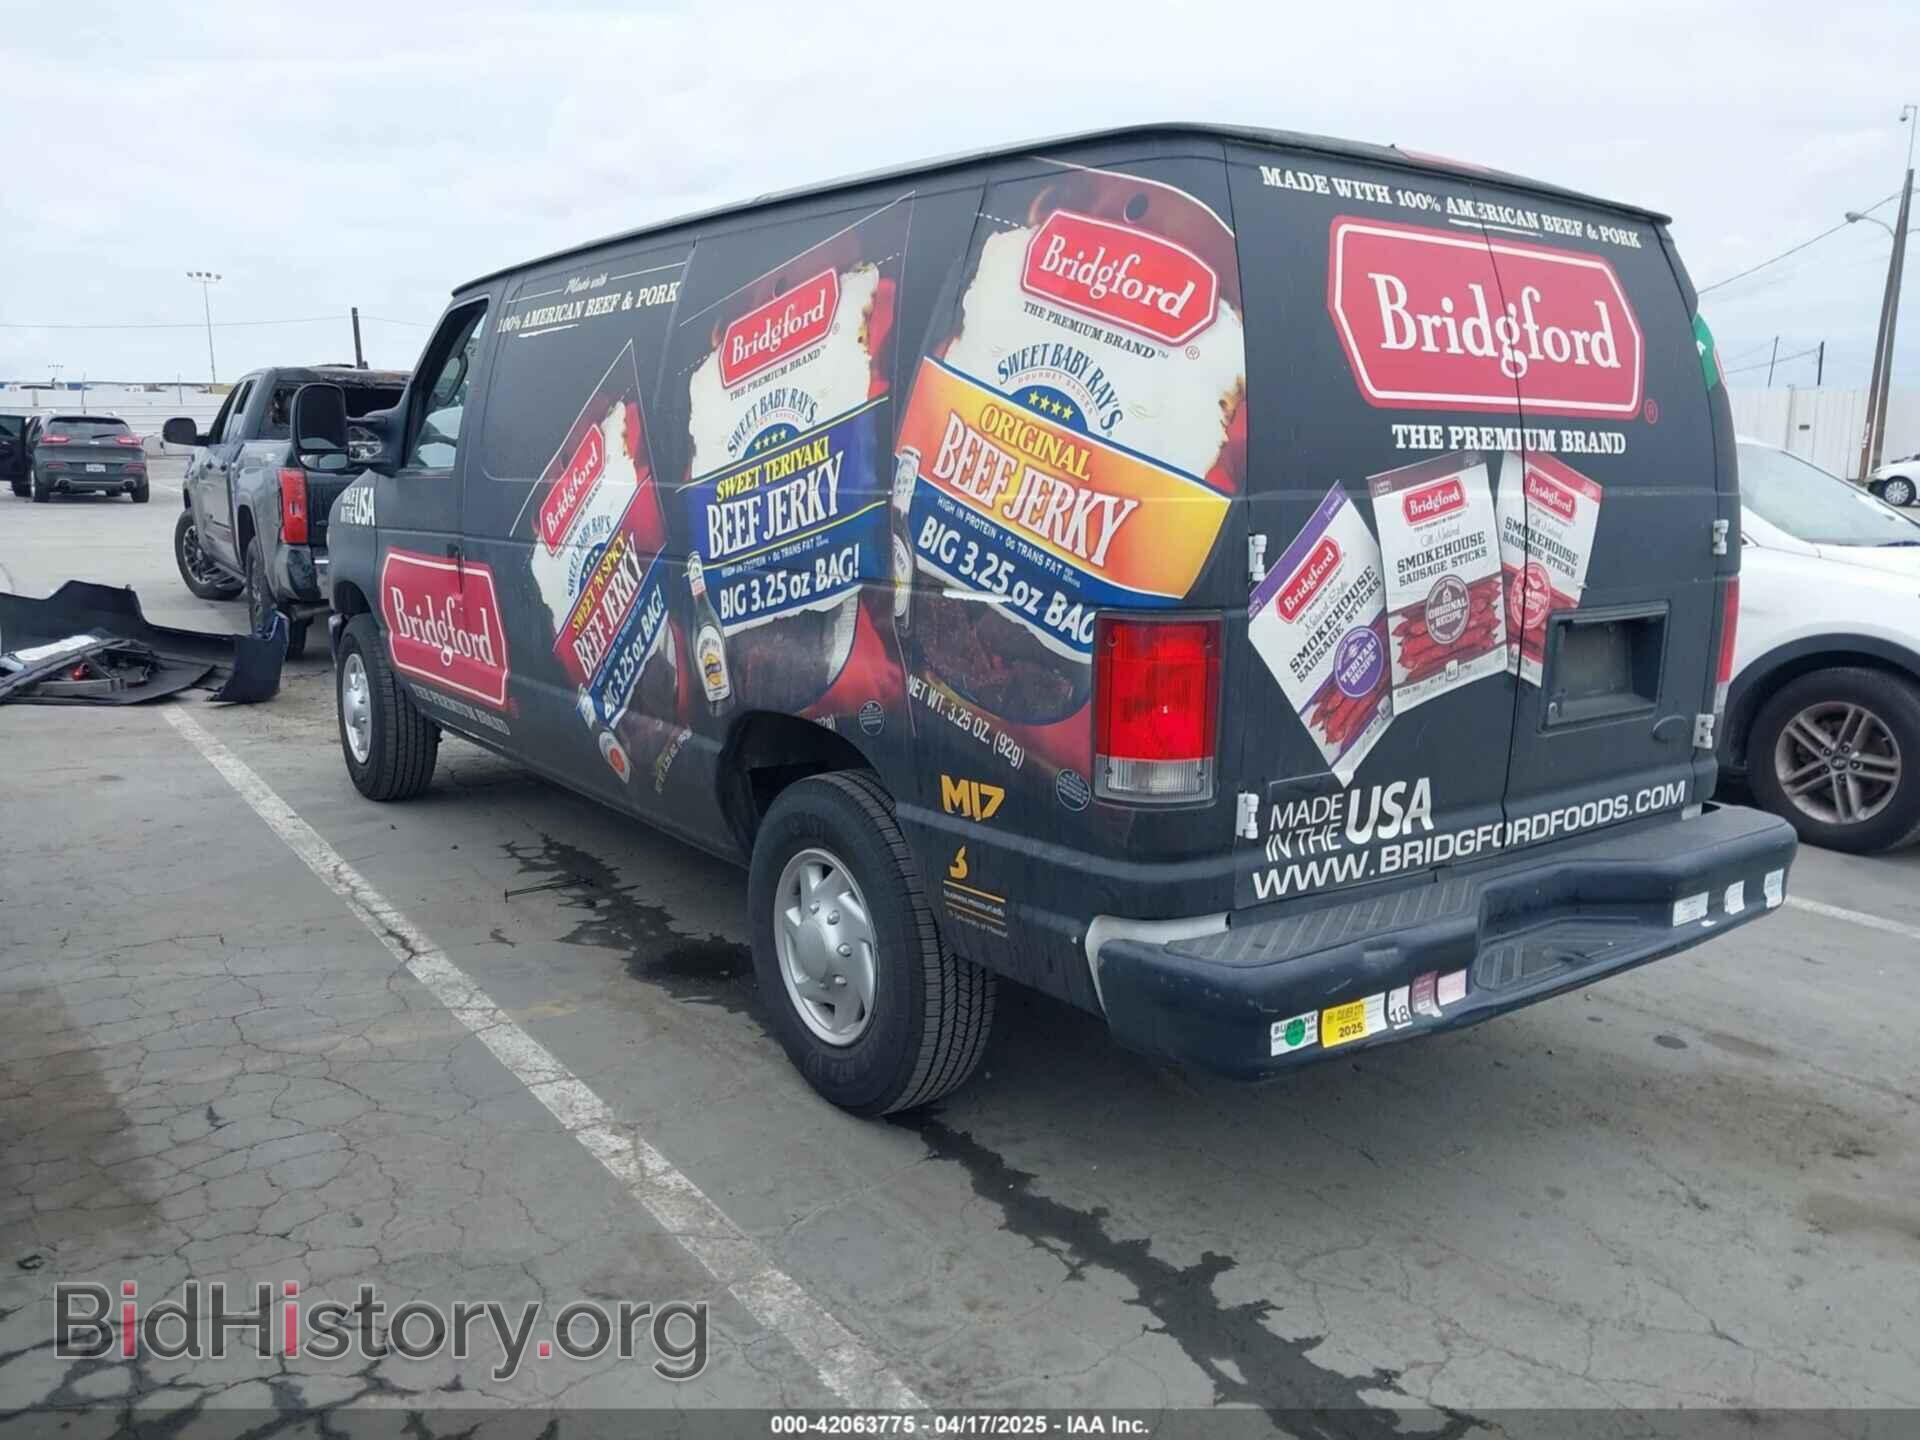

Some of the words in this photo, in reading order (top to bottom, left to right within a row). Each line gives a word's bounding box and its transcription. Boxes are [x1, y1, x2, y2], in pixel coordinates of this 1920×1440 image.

[1259, 166, 1330, 195] MADE
[1331, 177, 1393, 205] WITH
[1396, 189, 1441, 213] 100%
[1541, 214, 1585, 239] BEEF
[1586, 225, 1599, 241] &
[1598, 224, 1642, 249] PORK
[497, 314, 522, 334] 100%
[521, 300, 585, 329] AMERICAN
[584, 293, 621, 318] BEEF
[621, 290, 633, 311] &
[635, 281, 682, 308] PORK
[1039, 233, 1197, 320] Bridgford
[731, 288, 827, 367] Bridgford
[1023, 301, 1046, 319] THE
[1046, 308, 1102, 343] PREMIUM
[1368, 272, 1622, 379] Bridgford
[747, 364, 788, 393] PREMIUM
[997, 342, 1050, 386] SWEET
[1050, 342, 1094, 381] BABY
[1086, 367, 1124, 431] RAY'S
[727, 402, 758, 458] SWEET
[760, 388, 788, 415] BABY
[979, 404, 1092, 482] ORIGINAL
[1392, 424, 1445, 450] THE
[1449, 426, 1556, 453] PREMIUM
[1560, 430, 1626, 455] BRAND
[546, 441, 599, 539] Bridgford
[716, 466, 762, 503] SWEET
[763, 435, 830, 484] TERIYAKI
[932, 410, 1018, 509] BEEF
[1003, 467, 1140, 568] JERKY
[1408, 485, 1461, 516] Bridgford
[1528, 477, 1573, 513] Bridgford
[354, 487, 376, 527] USA
[706, 496, 762, 560] BEEF
[763, 450, 844, 541] JERKY
[937, 495, 954, 513] HIGH
[955, 507, 964, 519] IN
[964, 513, 997, 540] PROTEIN
[1017, 541, 1044, 567] TRANS
[1044, 559, 1062, 576] FAT
[917, 515, 961, 565] BIG
[958, 541, 1015, 594] 3.25
[1397, 530, 1486, 575] SMOKEHOUSE
[1399, 560, 1448, 588] SAUSAGE
[1450, 545, 1488, 569] STICKS
[1504, 516, 1580, 567] SMOKEHOUSE
[1546, 554, 1577, 579] STICKS
[572, 608, 607, 681] BEEF
[601, 531, 644, 635] JERKY
[720, 583, 747, 620] BIG
[750, 570, 788, 612] 3.25
[815, 543, 860, 593] BAG!
[1283, 546, 1335, 614] Bridgford
[389, 586, 498, 667] Bridgford
[1288, 565, 1376, 675] SMOKEHOUSE
[1296, 622, 1345, 683] SAUSAGE
[1344, 576, 1382, 624] STICKS
[602, 680, 621, 720] BIG
[908, 673, 928, 701] NET
[927, 687, 945, 716] WT.
[947, 702, 971, 732] 3.25
[973, 716, 991, 745] OZ.
[993, 730, 1026, 771] (92g)
[1252, 780, 1687, 900] WWW.BRIDGFORDFOODS.COM
[1265, 829, 1293, 863] IN
[1297, 822, 1343, 854] THE
[1269, 792, 1346, 832] MADE
[1345, 776, 1435, 845] USA
[1338, 1021, 1364, 1038] 2025
